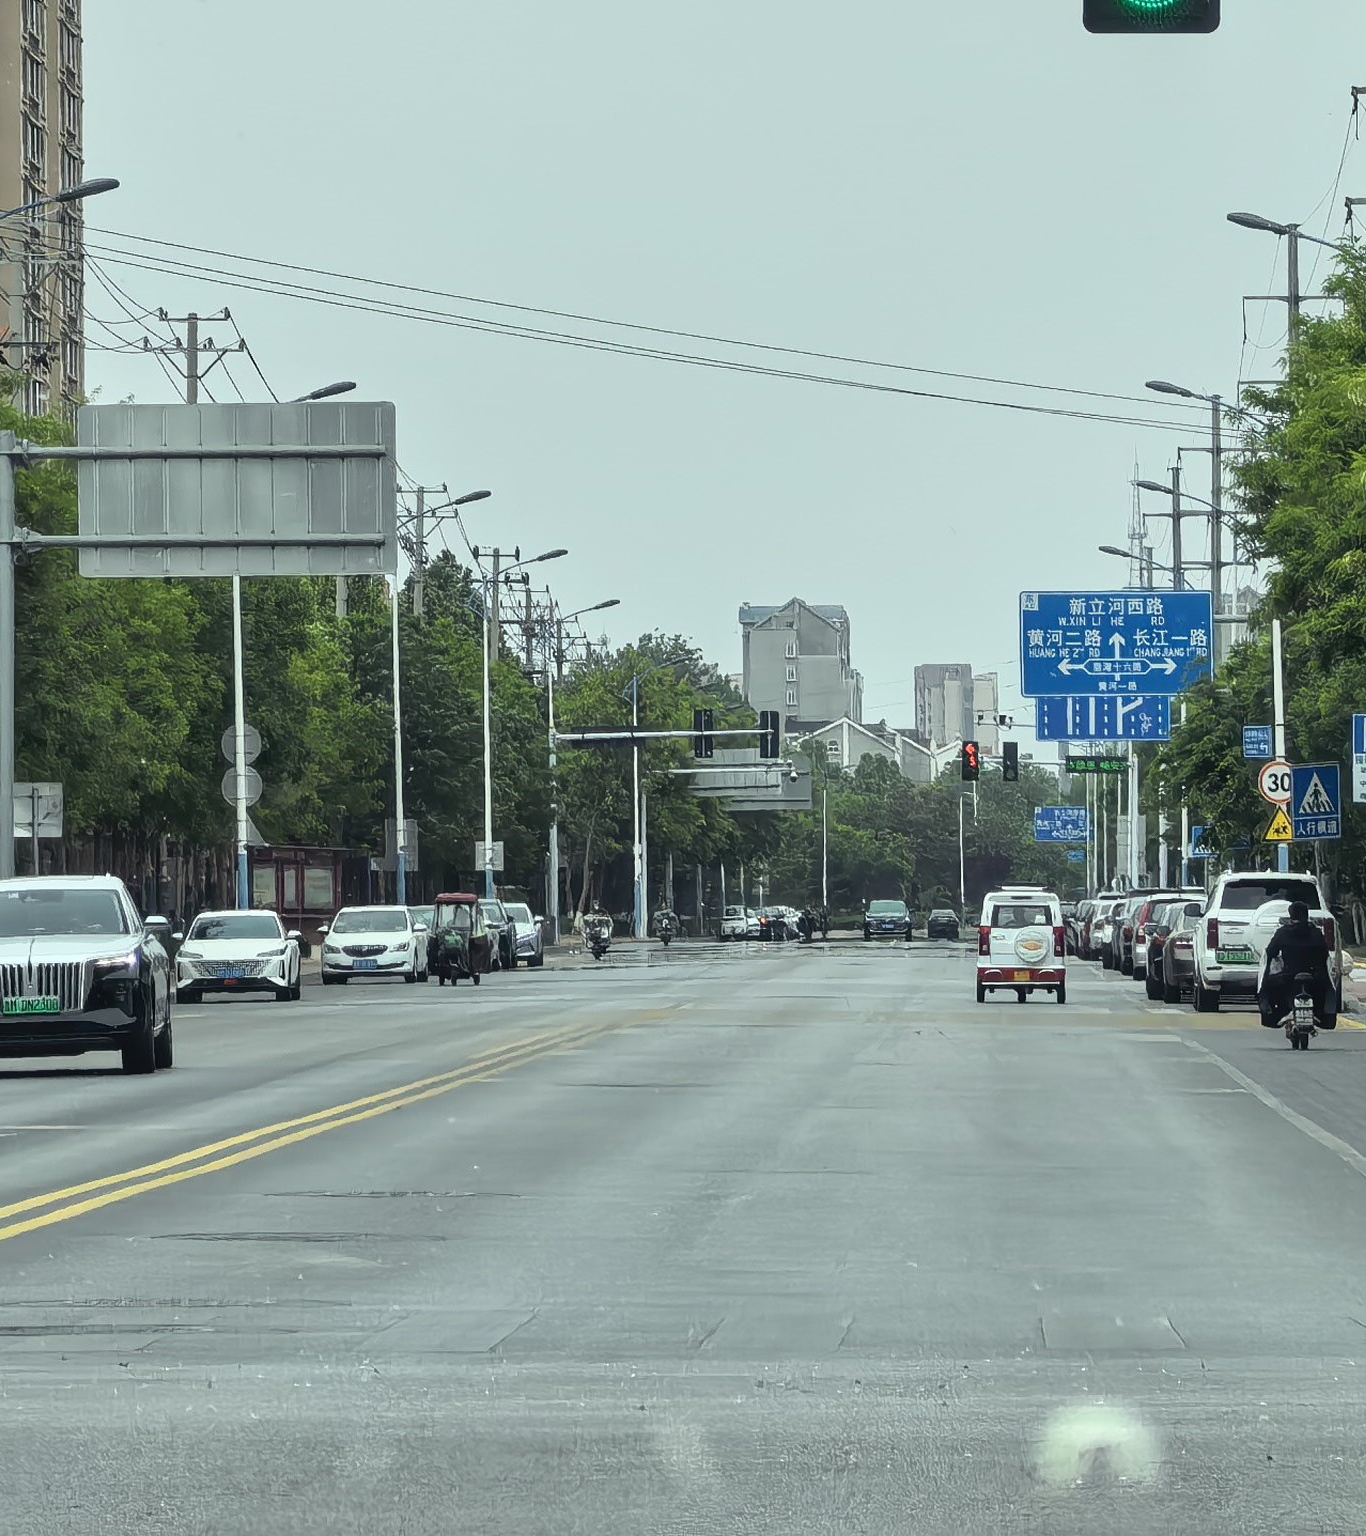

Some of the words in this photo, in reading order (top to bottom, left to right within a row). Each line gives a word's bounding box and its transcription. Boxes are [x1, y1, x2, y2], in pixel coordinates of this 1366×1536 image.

[1069, 597, 1164, 615] 新立河西路
[1092, 617, 1101, 626] LI
[1111, 617, 1124, 626] HE
[1151, 617, 1165, 626] RD
[1027, 629, 1102, 647] 黄河二路
[1133, 628, 1208, 647] 长江一路
[1029, 647, 1056, 658] HUANG
[1089, 648, 1100, 658] RD
[1196, 647, 1208, 657] RD
[1267, 772, 1291, 793] 30
